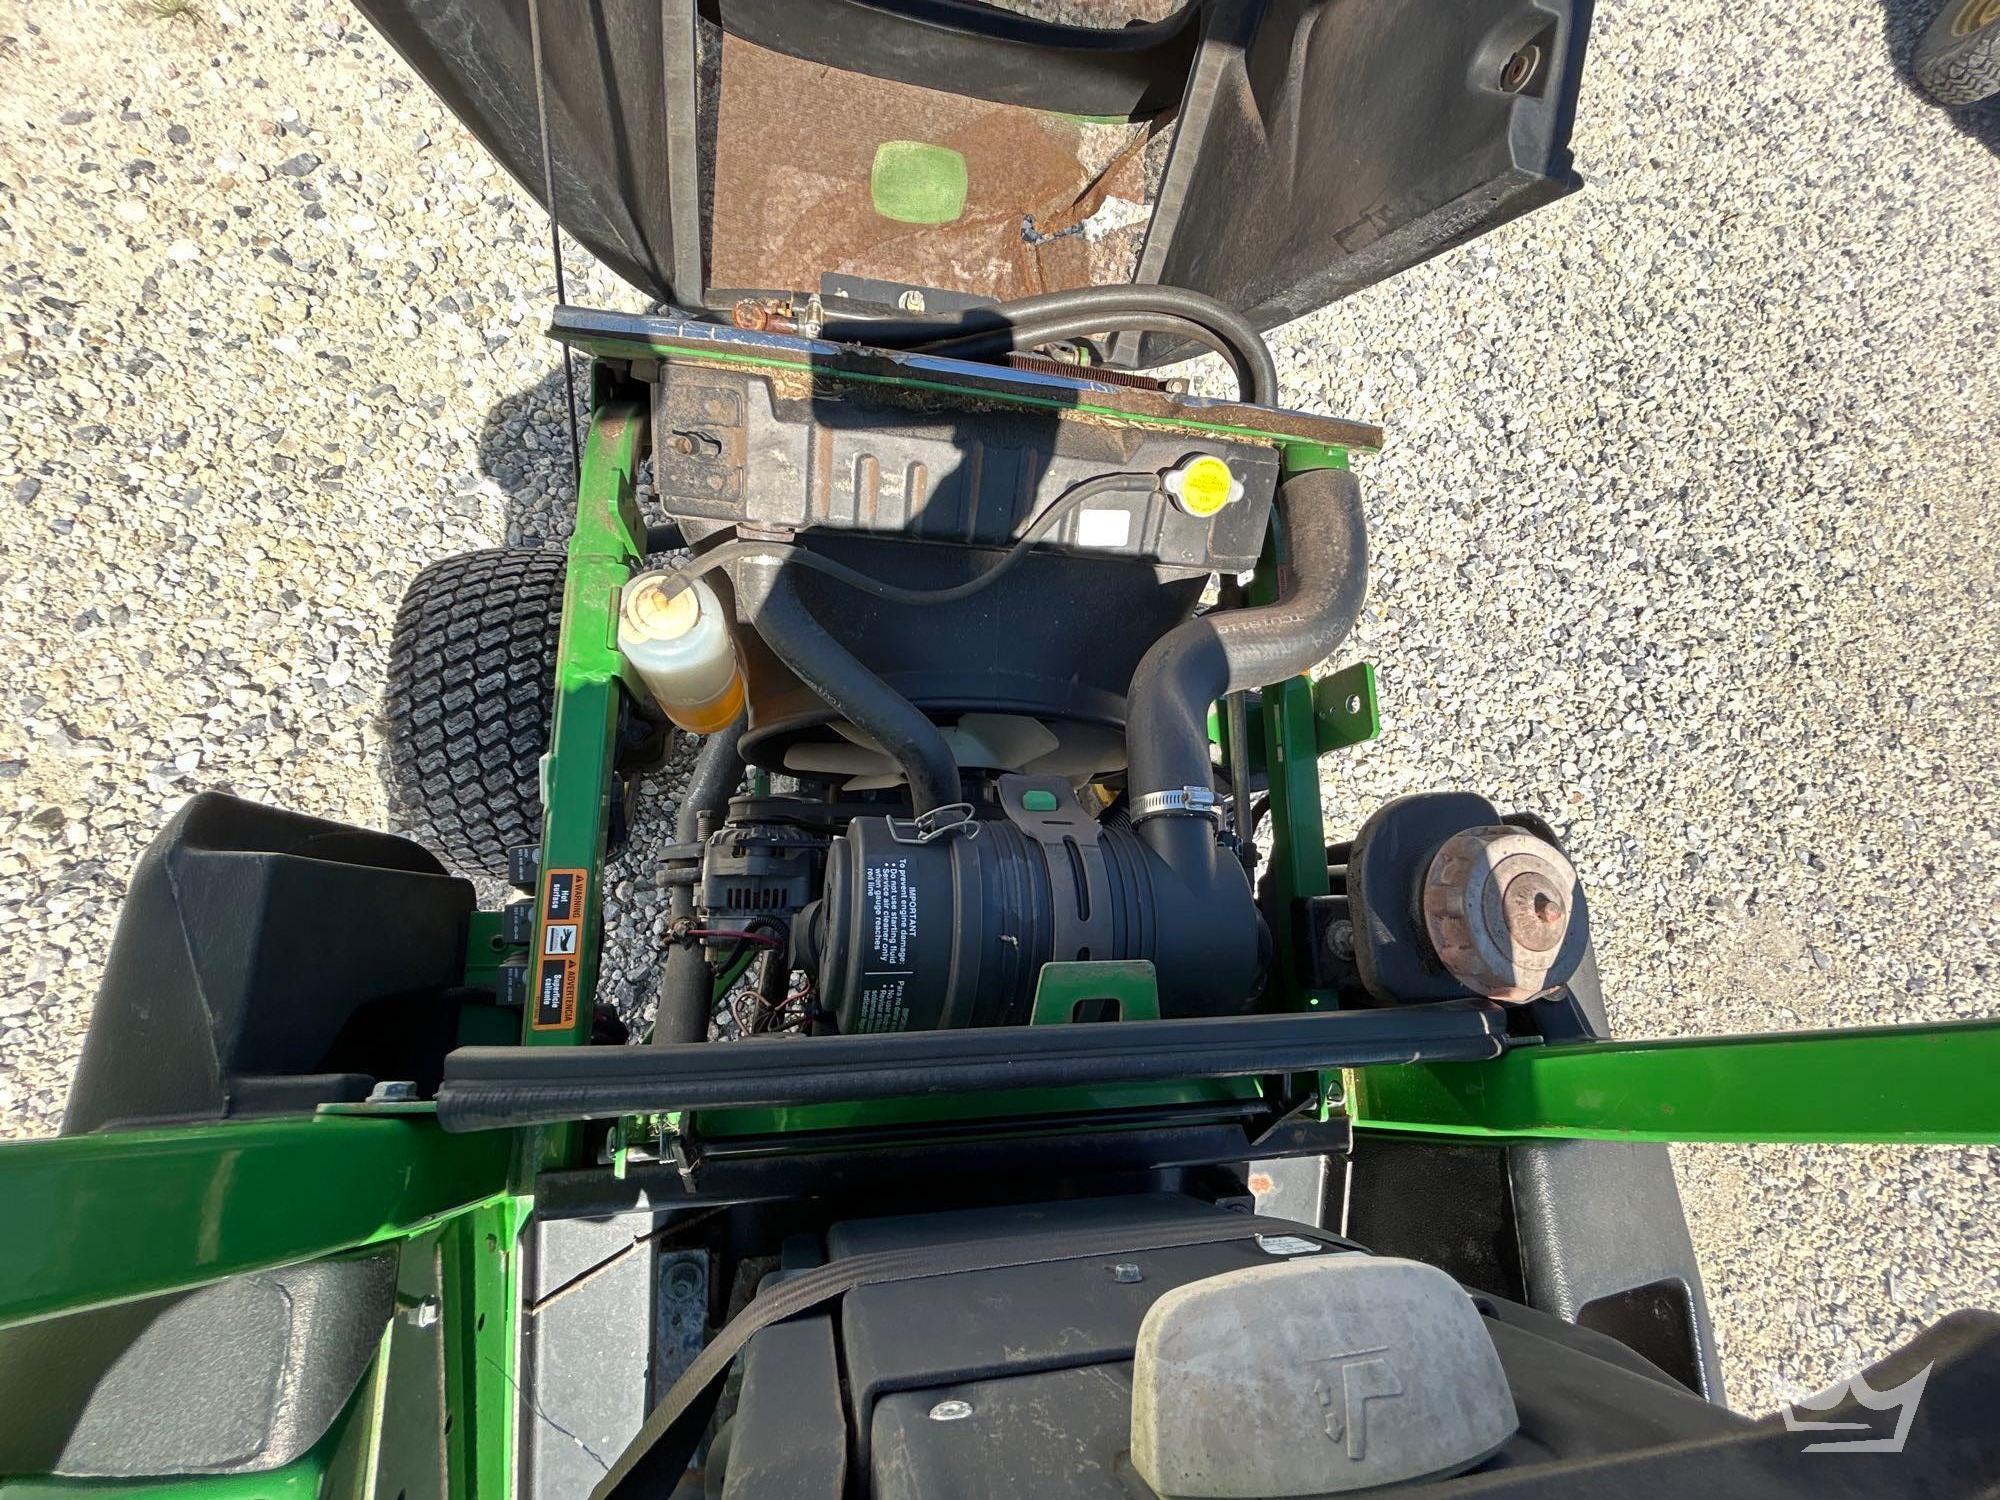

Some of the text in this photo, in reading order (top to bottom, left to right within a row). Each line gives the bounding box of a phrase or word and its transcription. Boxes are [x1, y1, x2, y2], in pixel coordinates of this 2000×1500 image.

[867, 867, 875, 897] red line
[882, 868, 890, 897] Service
[890, 868, 898, 879] Do
[890, 880, 898, 893] not
[551, 883, 561, 909] surface
[560, 889, 570, 903] Hot
[572, 883, 584, 918] WARNING
[873, 889, 882, 916] gauge
[882, 910, 890, 942] cleaner
[898, 858, 908, 965] To prevent engine damage:
[908, 886, 917, 937] IMPORTANT
[874, 916, 882, 950] reaches
[888, 911, 898, 944] starting
[880, 943, 889, 962] only
[889, 945, 898, 964] fluid
[543, 977, 552, 1006] caliente
[551, 974, 562, 1009] Superficie
[564, 970, 577, 1022] ADVERTENCIA
[896, 980, 905, 997] Para
